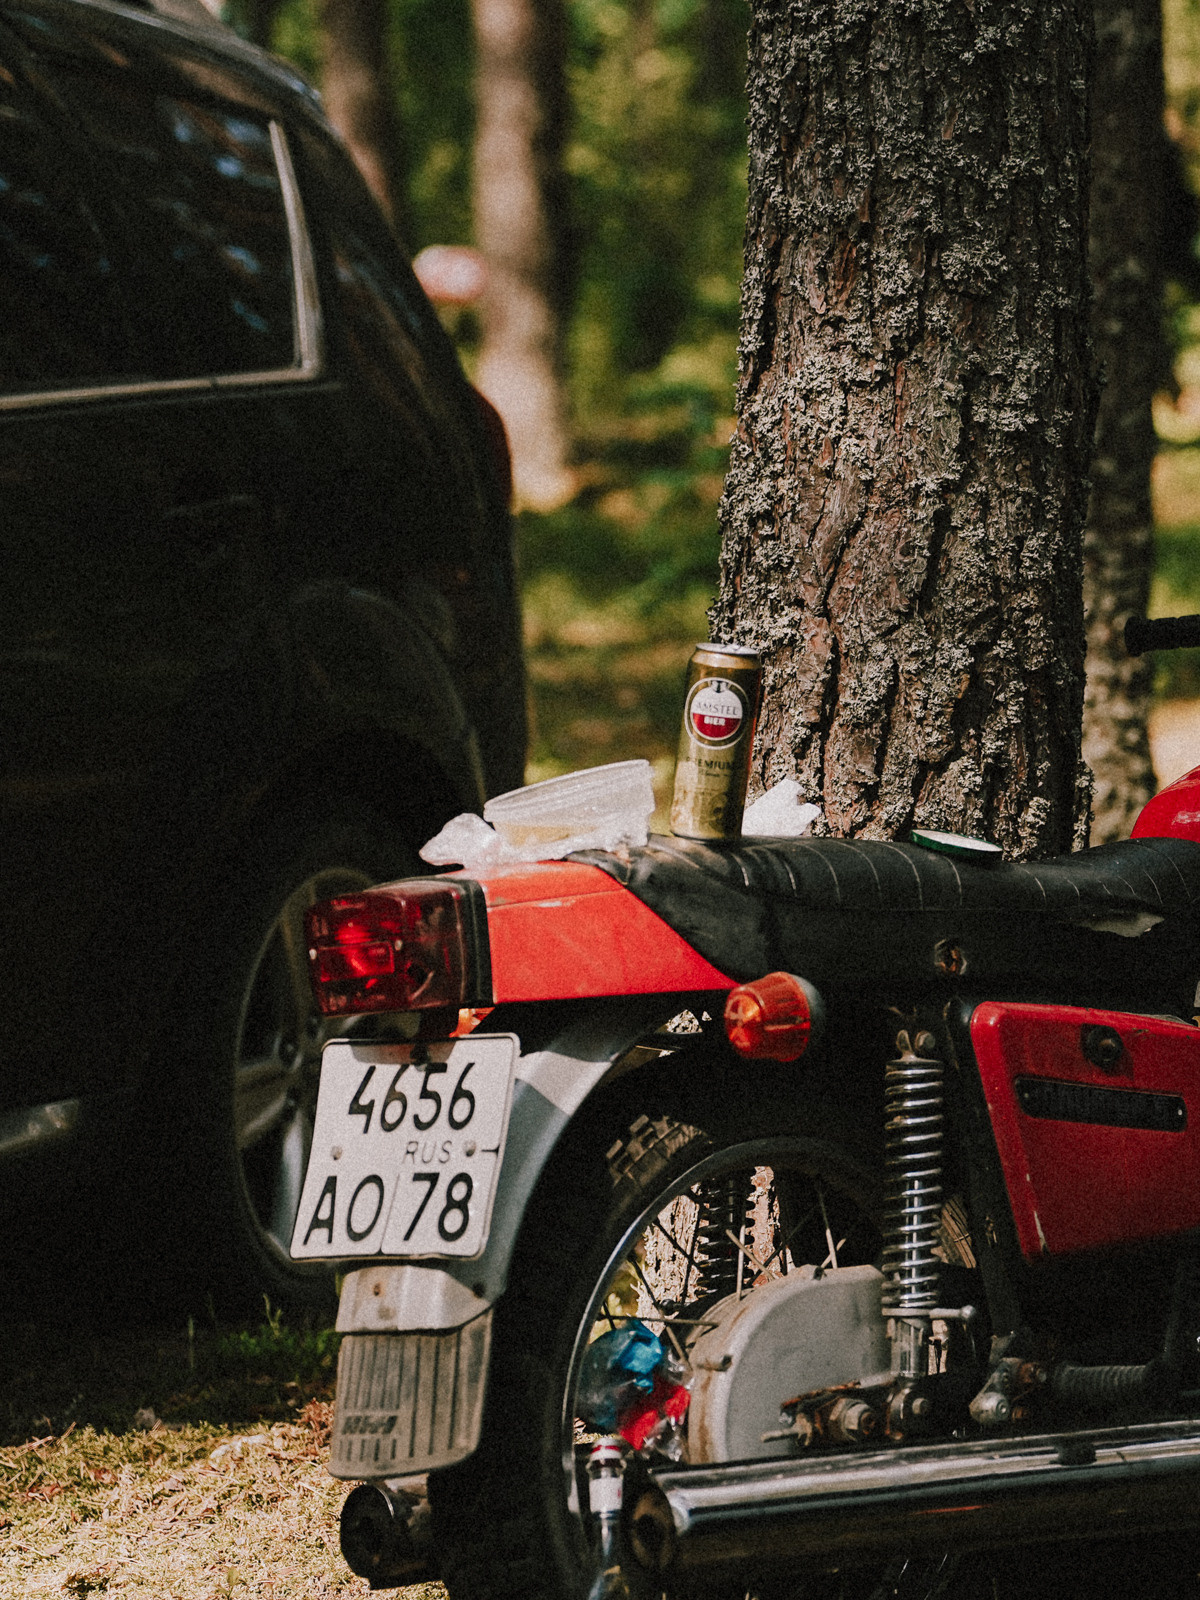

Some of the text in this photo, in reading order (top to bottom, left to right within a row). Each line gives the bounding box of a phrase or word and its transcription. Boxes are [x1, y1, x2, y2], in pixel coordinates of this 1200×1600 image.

[704, 716, 725, 726] BIER
[348, 1062, 475, 1134] 4656
[402, 1140, 452, 1164] RUS
[403, 1172, 473, 1242] 78
